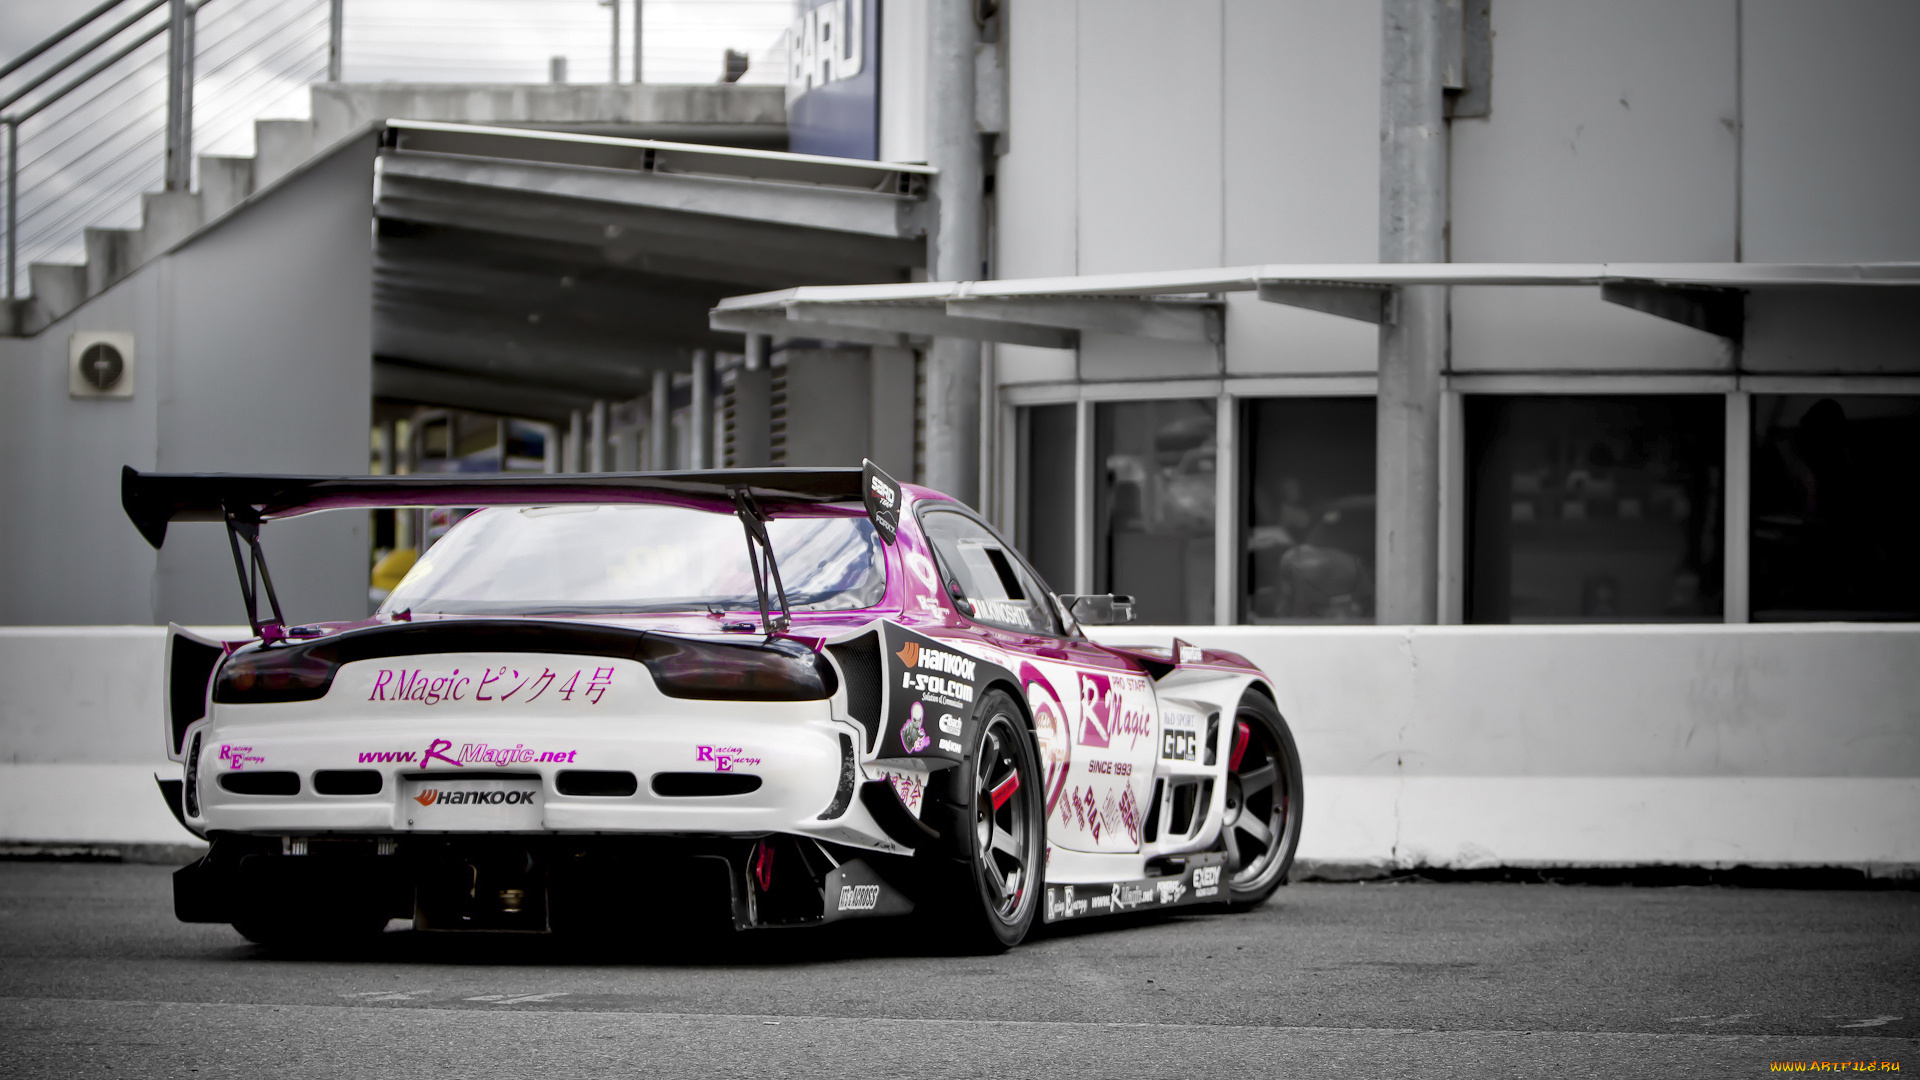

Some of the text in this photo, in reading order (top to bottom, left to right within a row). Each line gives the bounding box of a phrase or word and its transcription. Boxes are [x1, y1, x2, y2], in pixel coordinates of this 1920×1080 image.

[475, 666, 615, 705] ピンク4号
[1111, 675, 1146, 693] PRO STAFF
[1176, 713, 1195, 727] SPORT
[696, 744, 743, 763] Racing
[1161, 728, 1196, 761] GCG
[714, 754, 762, 773] Energy
[1088, 759, 1133, 777] SINCE 1993
[1083, 784, 1101, 846] PIAA
[1192, 865, 1222, 888] EXEDY
